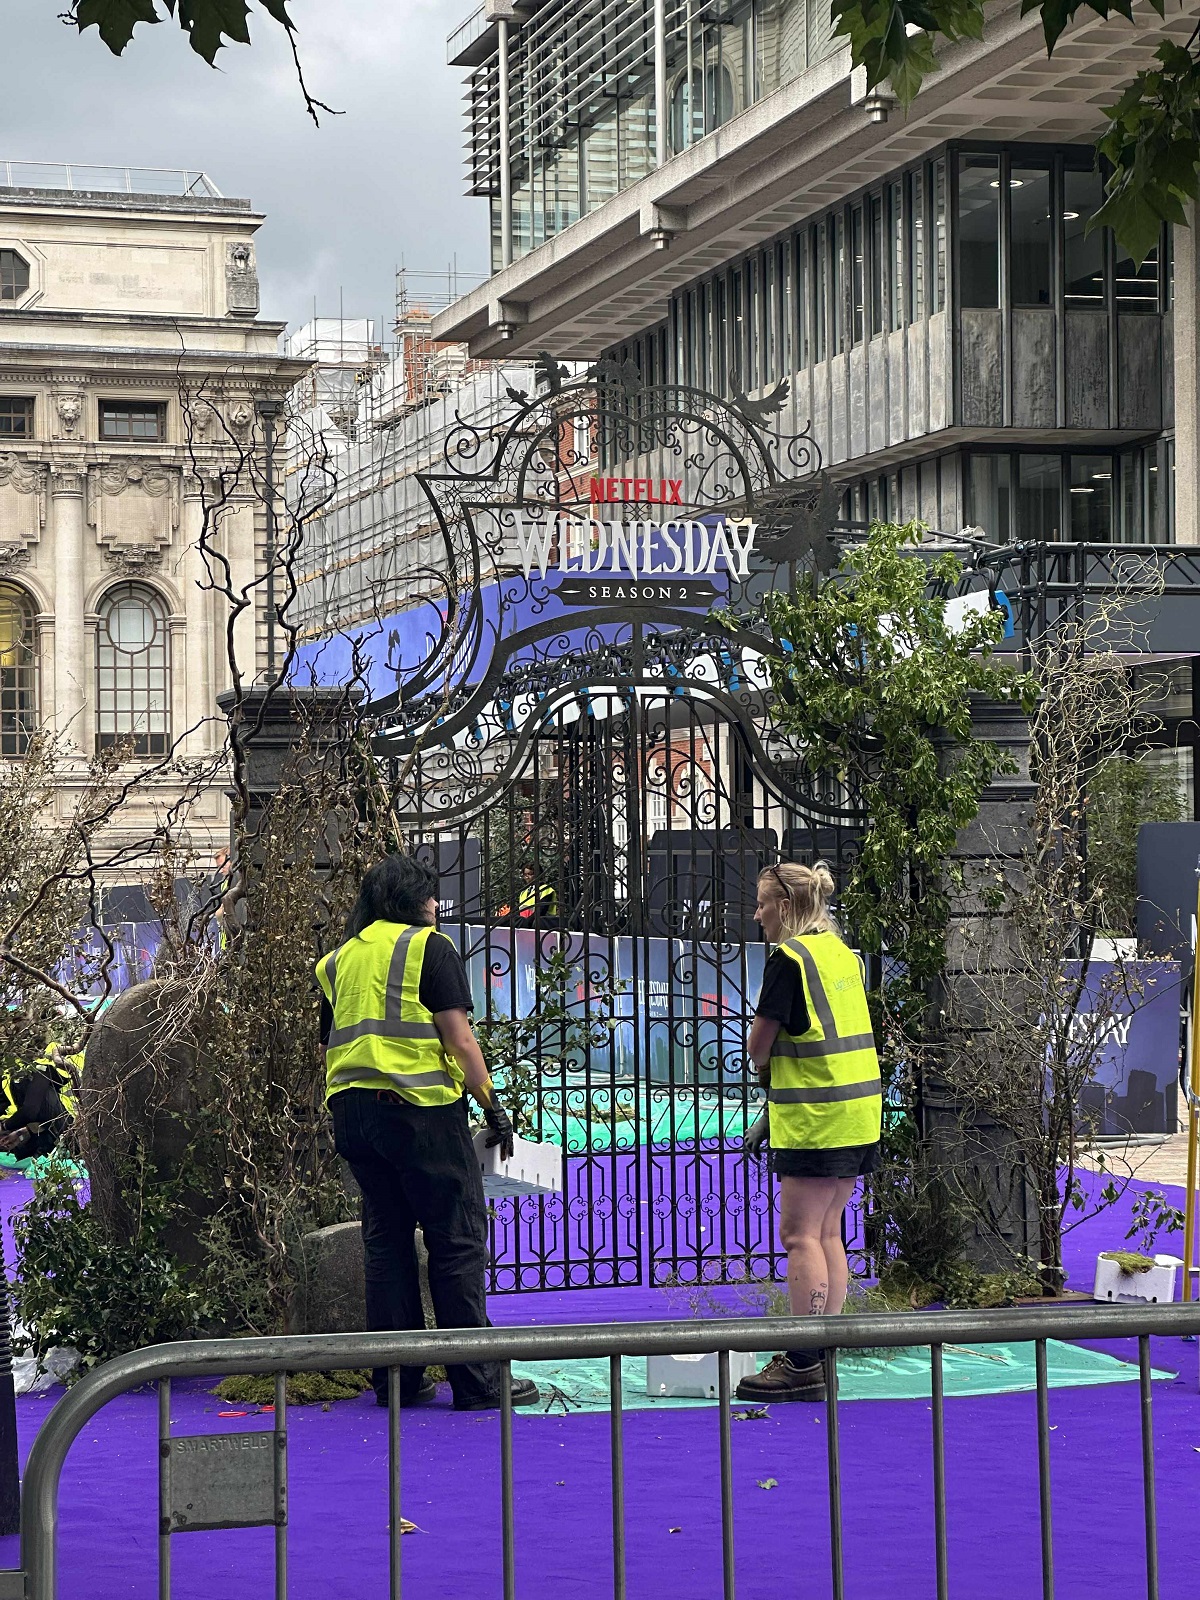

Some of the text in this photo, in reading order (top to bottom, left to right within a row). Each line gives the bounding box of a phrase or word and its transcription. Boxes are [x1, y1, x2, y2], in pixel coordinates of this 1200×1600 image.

[590, 478, 683, 505] NETFLIX
[511, 509, 759, 583] WEDNESDAY
[589, 586, 688, 599] SEASON 2
[177, 1436, 269, 1454] SMARTWELD
